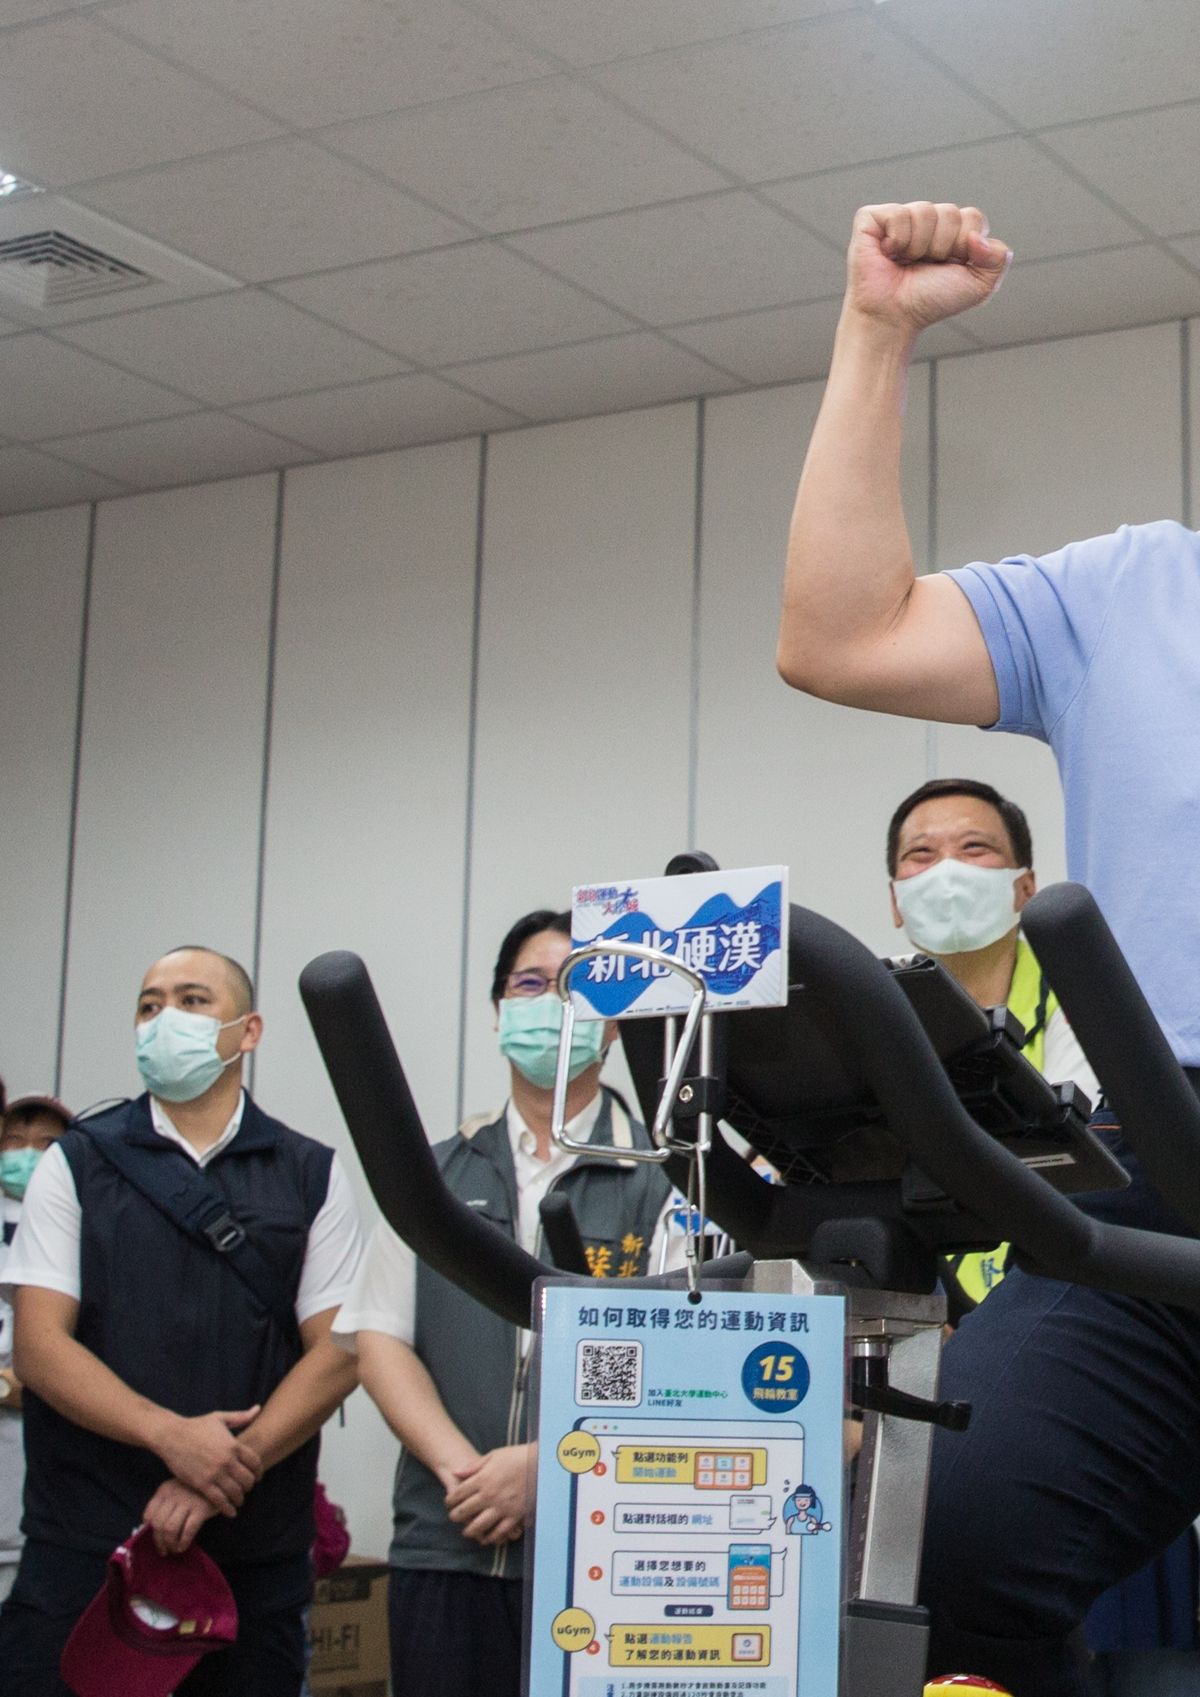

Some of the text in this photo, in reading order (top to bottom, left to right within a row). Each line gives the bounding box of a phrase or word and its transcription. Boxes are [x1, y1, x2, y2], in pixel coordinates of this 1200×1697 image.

[587, 921, 763, 984] 新北硬漢
[577, 1306, 811, 1333] 如何取得您的運動資訊
[759, 1355, 796, 1381] 15
[562, 1447, 596, 1459] uGym
[557, 1625, 591, 1637] uGym
